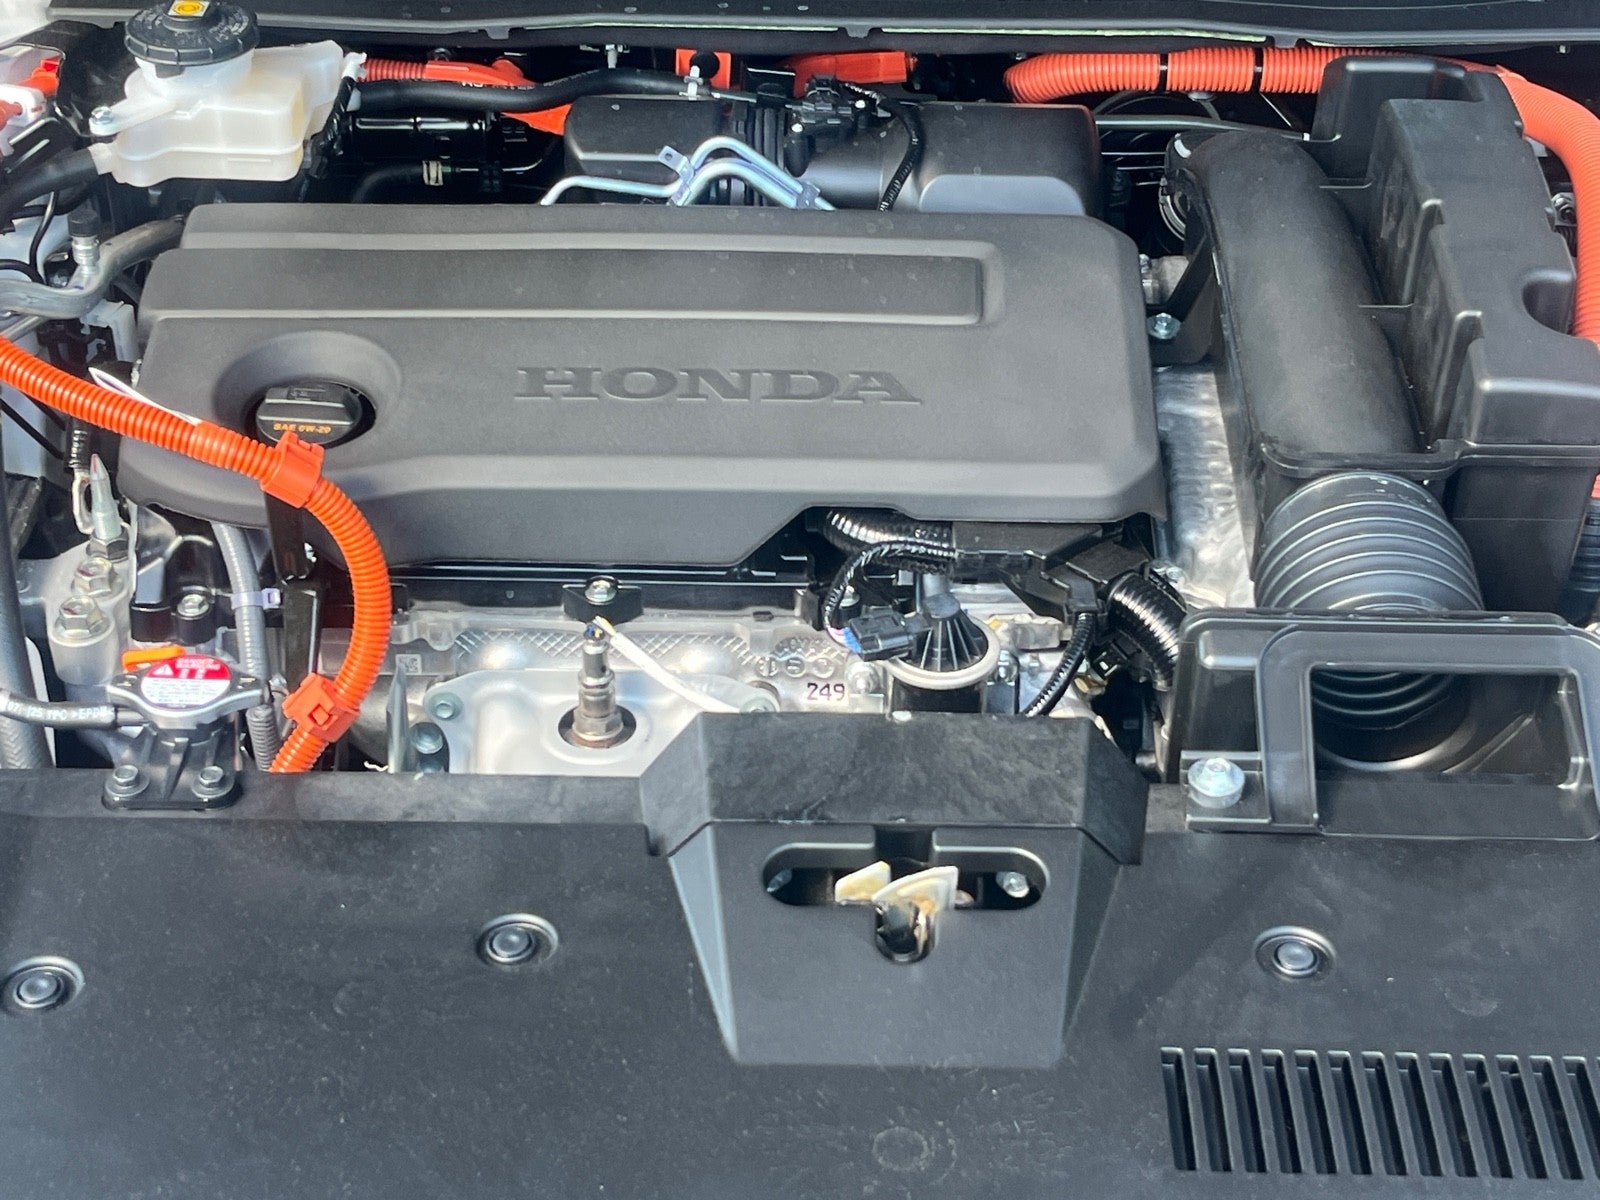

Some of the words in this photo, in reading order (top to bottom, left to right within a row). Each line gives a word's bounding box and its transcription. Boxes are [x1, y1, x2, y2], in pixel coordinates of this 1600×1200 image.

[514, 366, 922, 406] HONDA
[273, 423, 297, 431] SAE
[806, 682, 846, 701] 249
